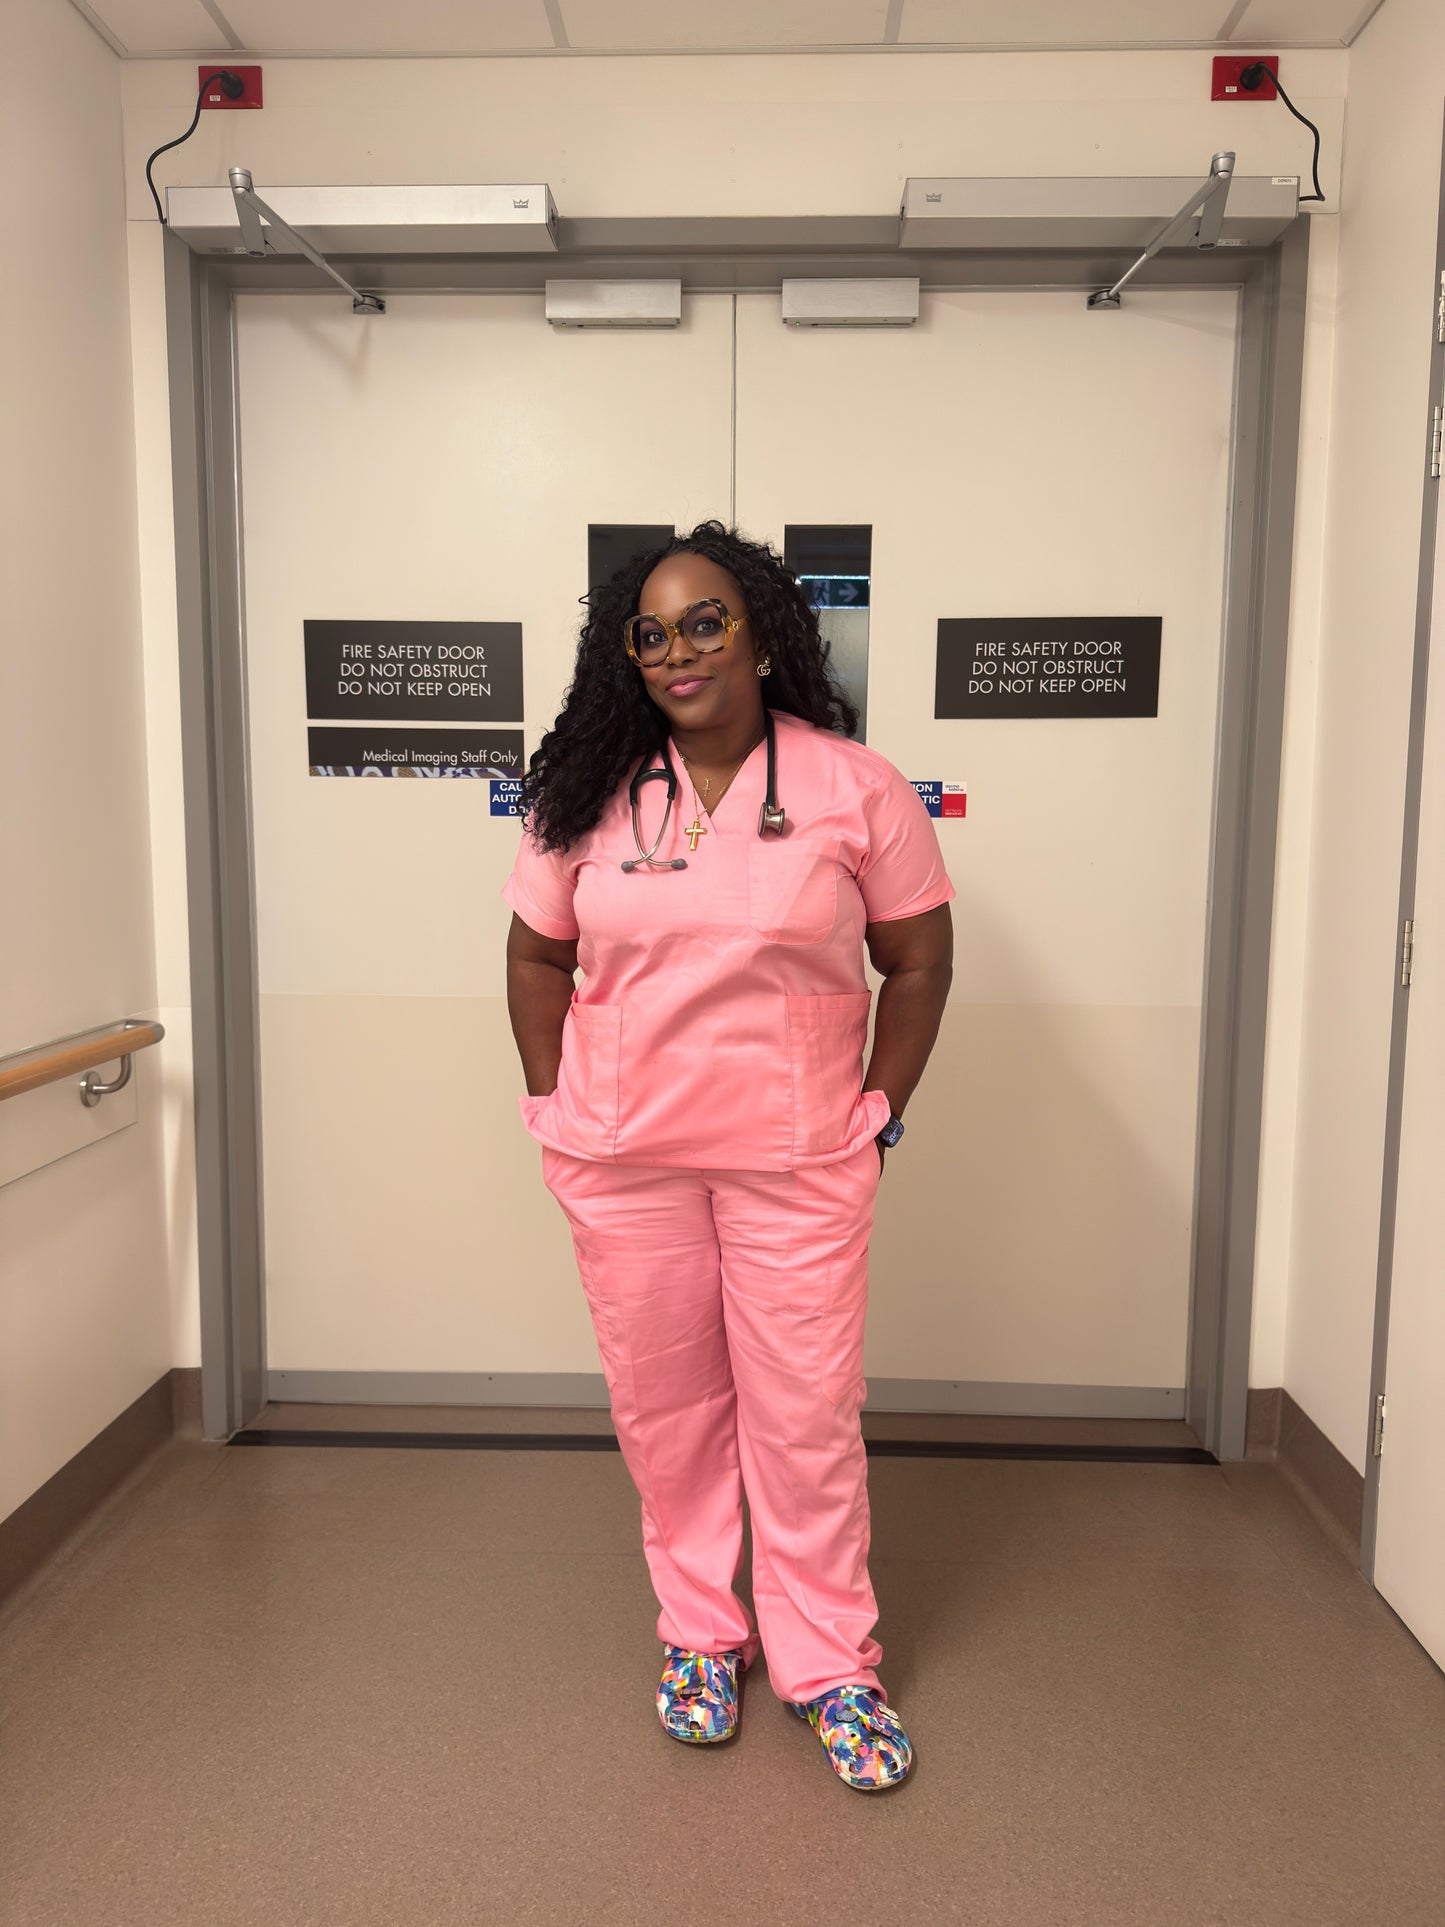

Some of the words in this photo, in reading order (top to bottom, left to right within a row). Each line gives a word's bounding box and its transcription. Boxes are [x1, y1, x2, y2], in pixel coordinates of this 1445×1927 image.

[343, 645, 372, 658] FIRE
[378, 645, 432, 659] SAFETY
[438, 646, 484, 659] DOOR
[976, 643, 1005, 656] FIRE
[1012, 642, 1068, 656] SAFETY
[1074, 642, 1121, 655] DOOR
[341, 663, 365, 676] DO
[371, 664, 404, 677] NOT
[410, 664, 488, 678] OBSTRUCT
[973, 662, 997, 675] DO
[1003, 661, 1037, 674] NOT
[1043, 660, 1124, 674] OBSTRUCT
[338, 682, 362, 695] DO
[368, 682, 401, 695] NOT
[408, 683, 442, 695] KEEP
[448, 683, 490, 696] OPEN
[969, 680, 993, 693] DO
[999, 680, 1034, 693] NOT
[1040, 679, 1076, 692] KEEP
[1082, 679, 1125, 692] OPEN
[363, 749, 407, 761] Medical
[412, 751, 457, 765] Imaging
[462, 750, 487, 762] Staff
[490, 750, 518, 766] Only
[499, 783, 523, 791] CAU
[921, 795, 940, 804] TIC
